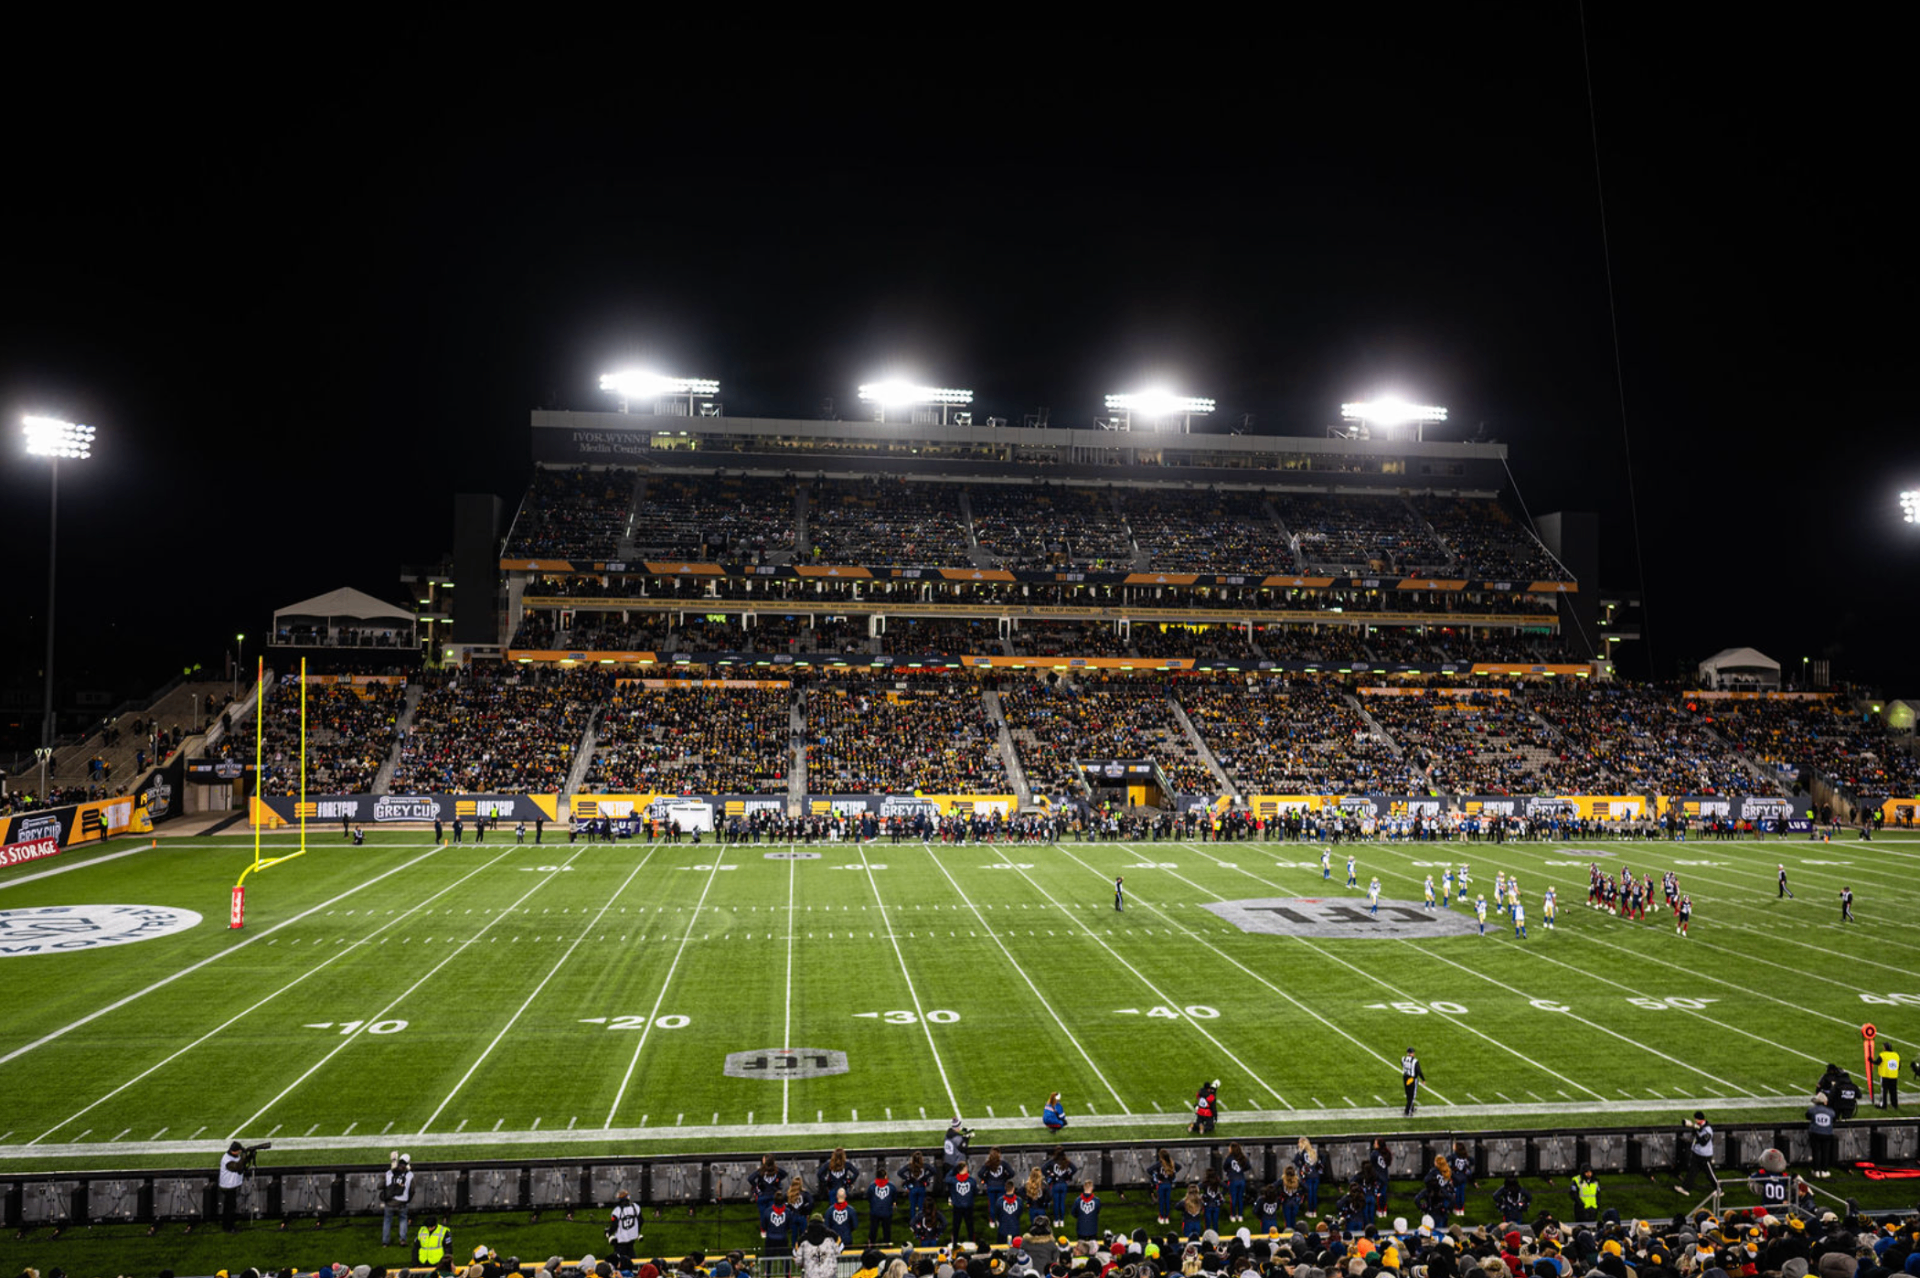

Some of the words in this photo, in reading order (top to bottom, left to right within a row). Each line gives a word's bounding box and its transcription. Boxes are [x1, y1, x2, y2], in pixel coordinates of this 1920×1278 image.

[573, 431, 603, 442] IVOR
[605, 432, 649, 444] WYNNE
[579, 442, 611, 453] Media
[613, 443, 649, 454] Centre
[376, 805, 412, 818] GREY
[413, 805, 438, 818] CUP
[883, 804, 914, 817] GREY
[9, 840, 56, 863] STORAGE
[1389, 1001, 1470, 1015] 50
[1626, 997, 1707, 1011] 50
[883, 1010, 962, 1025] 30
[1146, 1005, 1222, 1020] 40
[339, 1019, 409, 1035] 10
[606, 1014, 692, 1030] 20
[1765, 1182, 1785, 1200] 00
